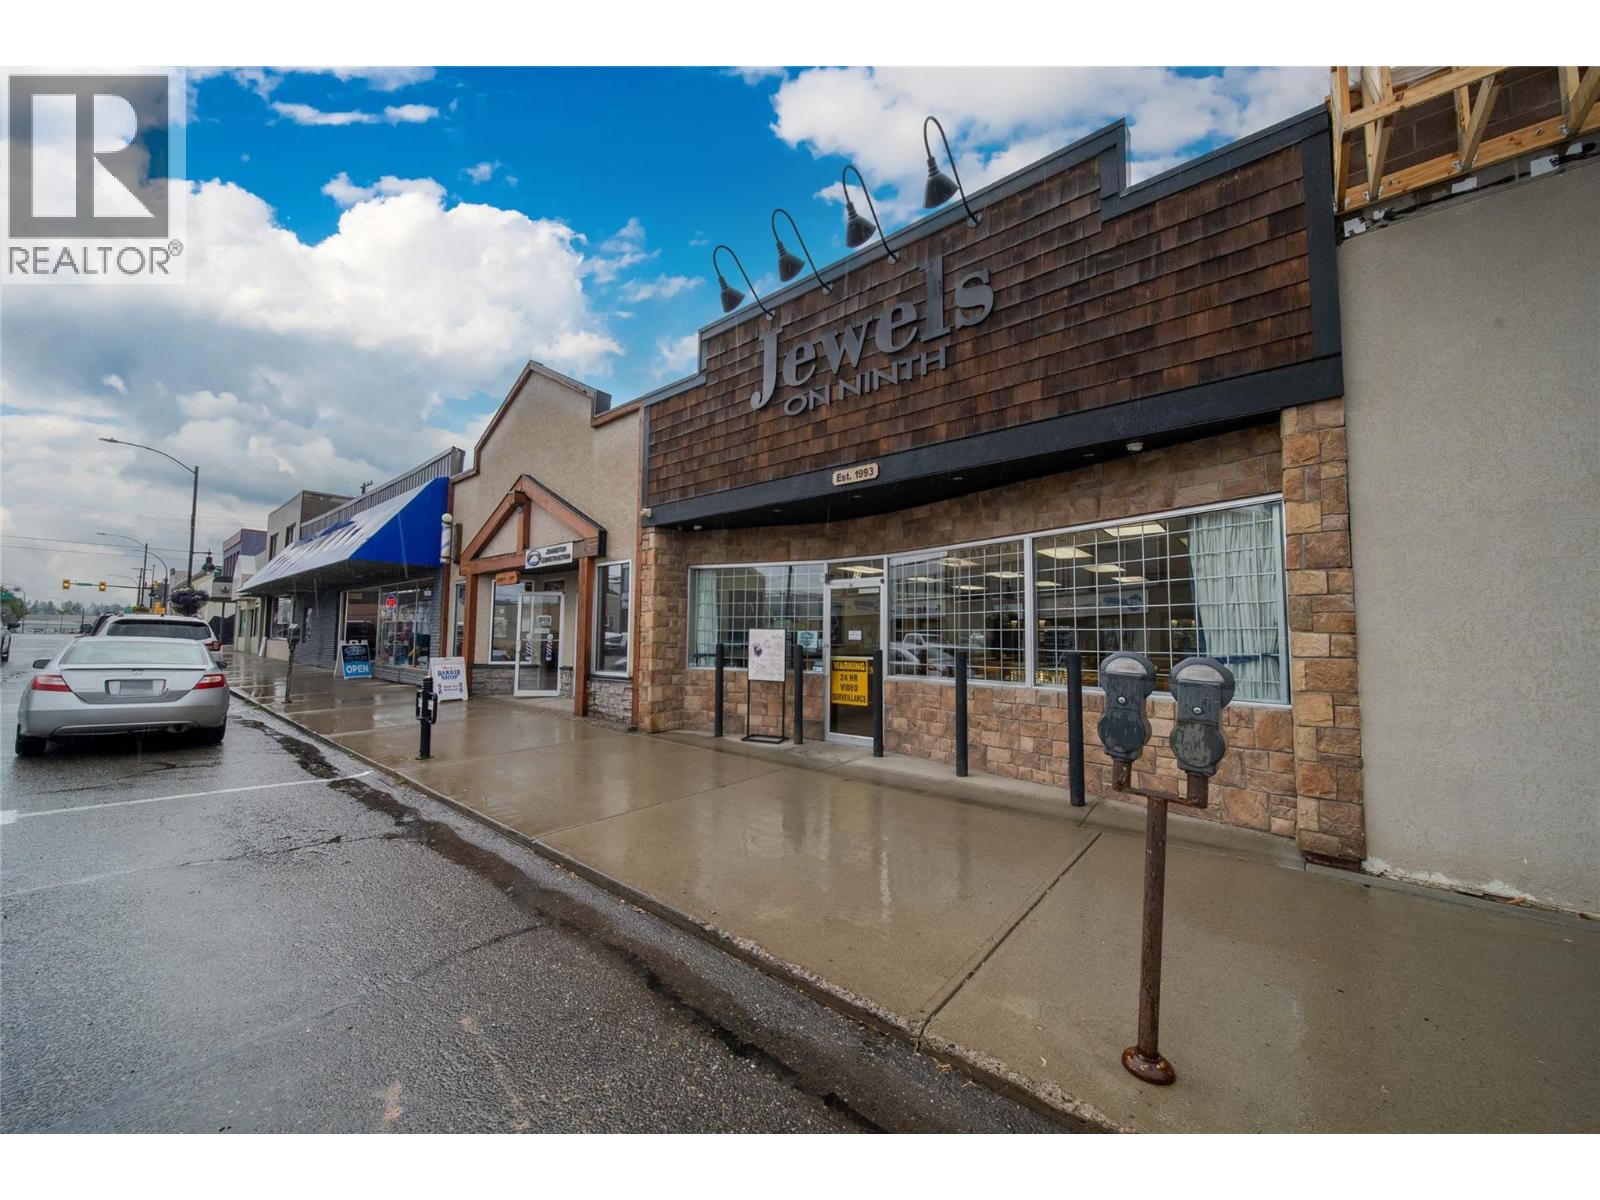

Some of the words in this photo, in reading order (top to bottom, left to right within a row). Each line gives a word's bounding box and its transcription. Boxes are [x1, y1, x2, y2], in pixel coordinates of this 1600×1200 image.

[750, 255, 995, 411] Jewels
[783, 384, 830, 416] ON
[838, 344, 950, 400] NINTH
[836, 472, 852, 482] Est.
[855, 466, 874, 479] 1993
[345, 664, 370, 674] OPEN
[833, 661, 866, 671] WARNING
[840, 673, 848, 682] 24
[849, 674, 858, 682] HR
[840, 684, 858, 692] VIDEO
